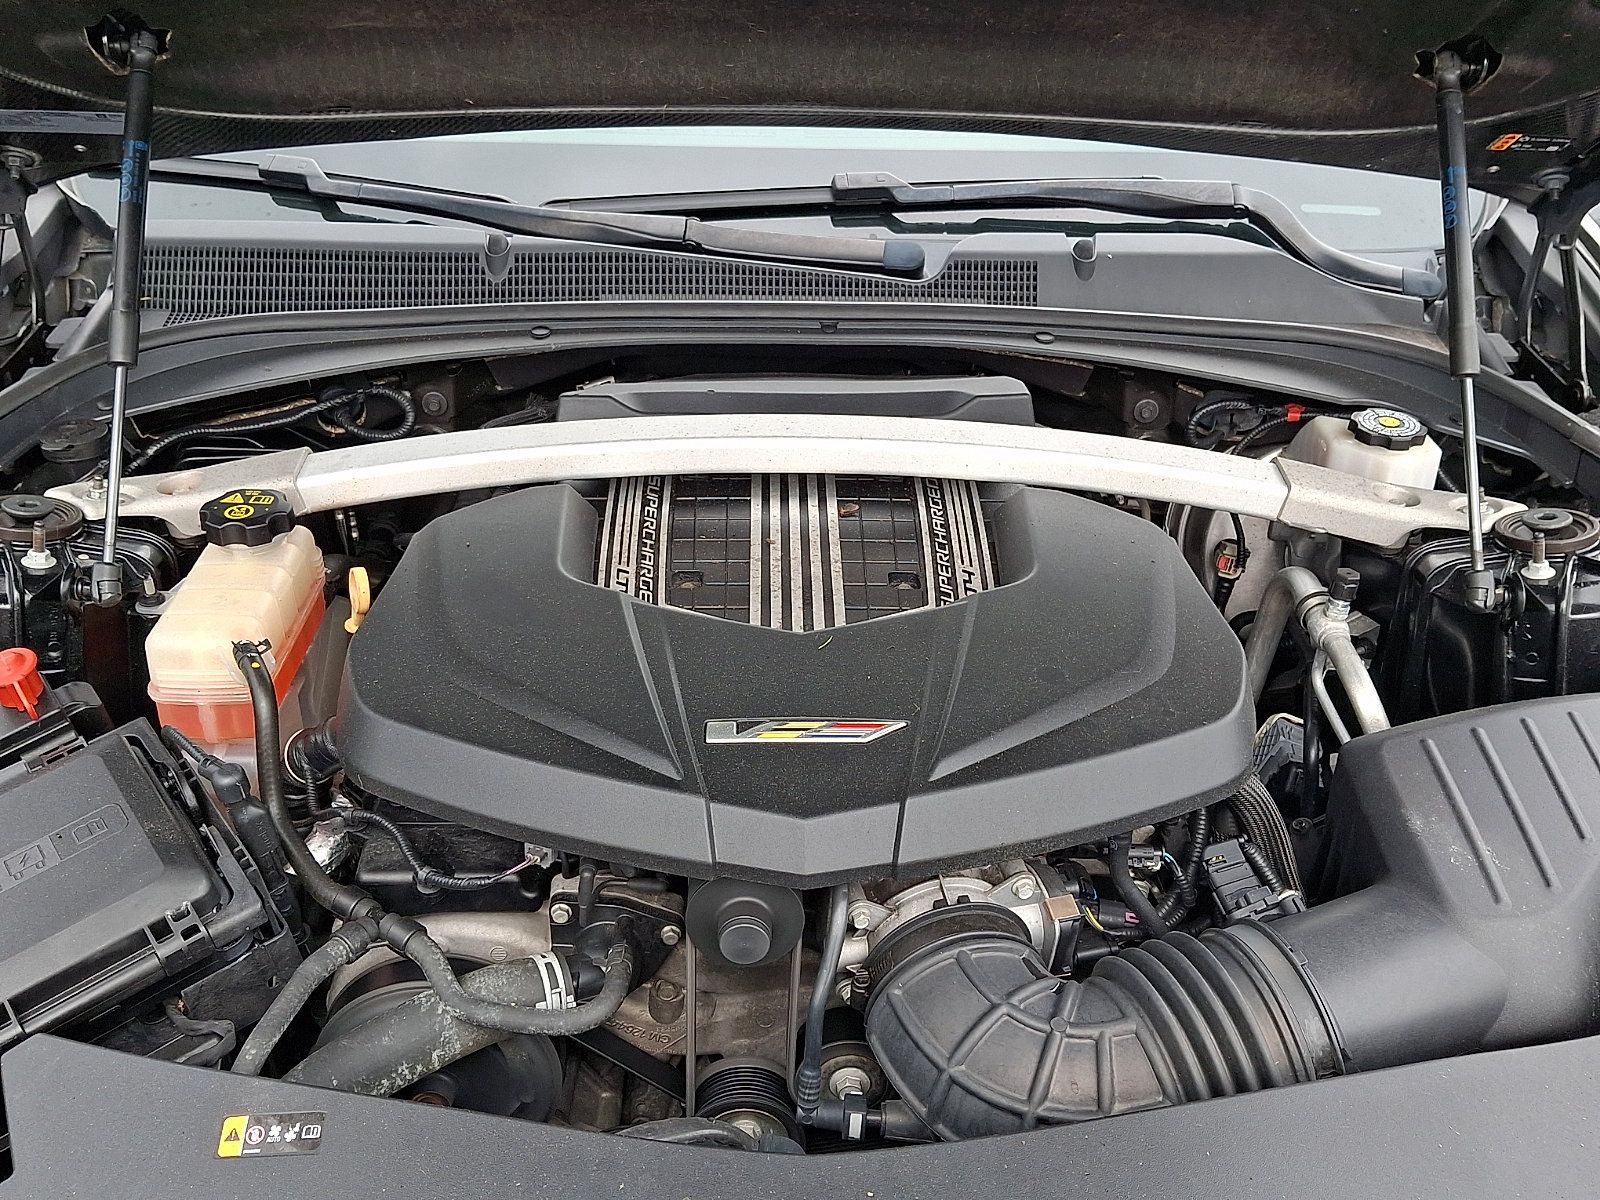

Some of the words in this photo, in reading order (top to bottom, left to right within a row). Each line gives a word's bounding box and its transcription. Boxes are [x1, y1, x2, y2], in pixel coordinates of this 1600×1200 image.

[638, 475, 661, 604] SUPERCHARGE
[961, 569, 978, 597] T4
[265, 1136, 282, 1144] AUTO
